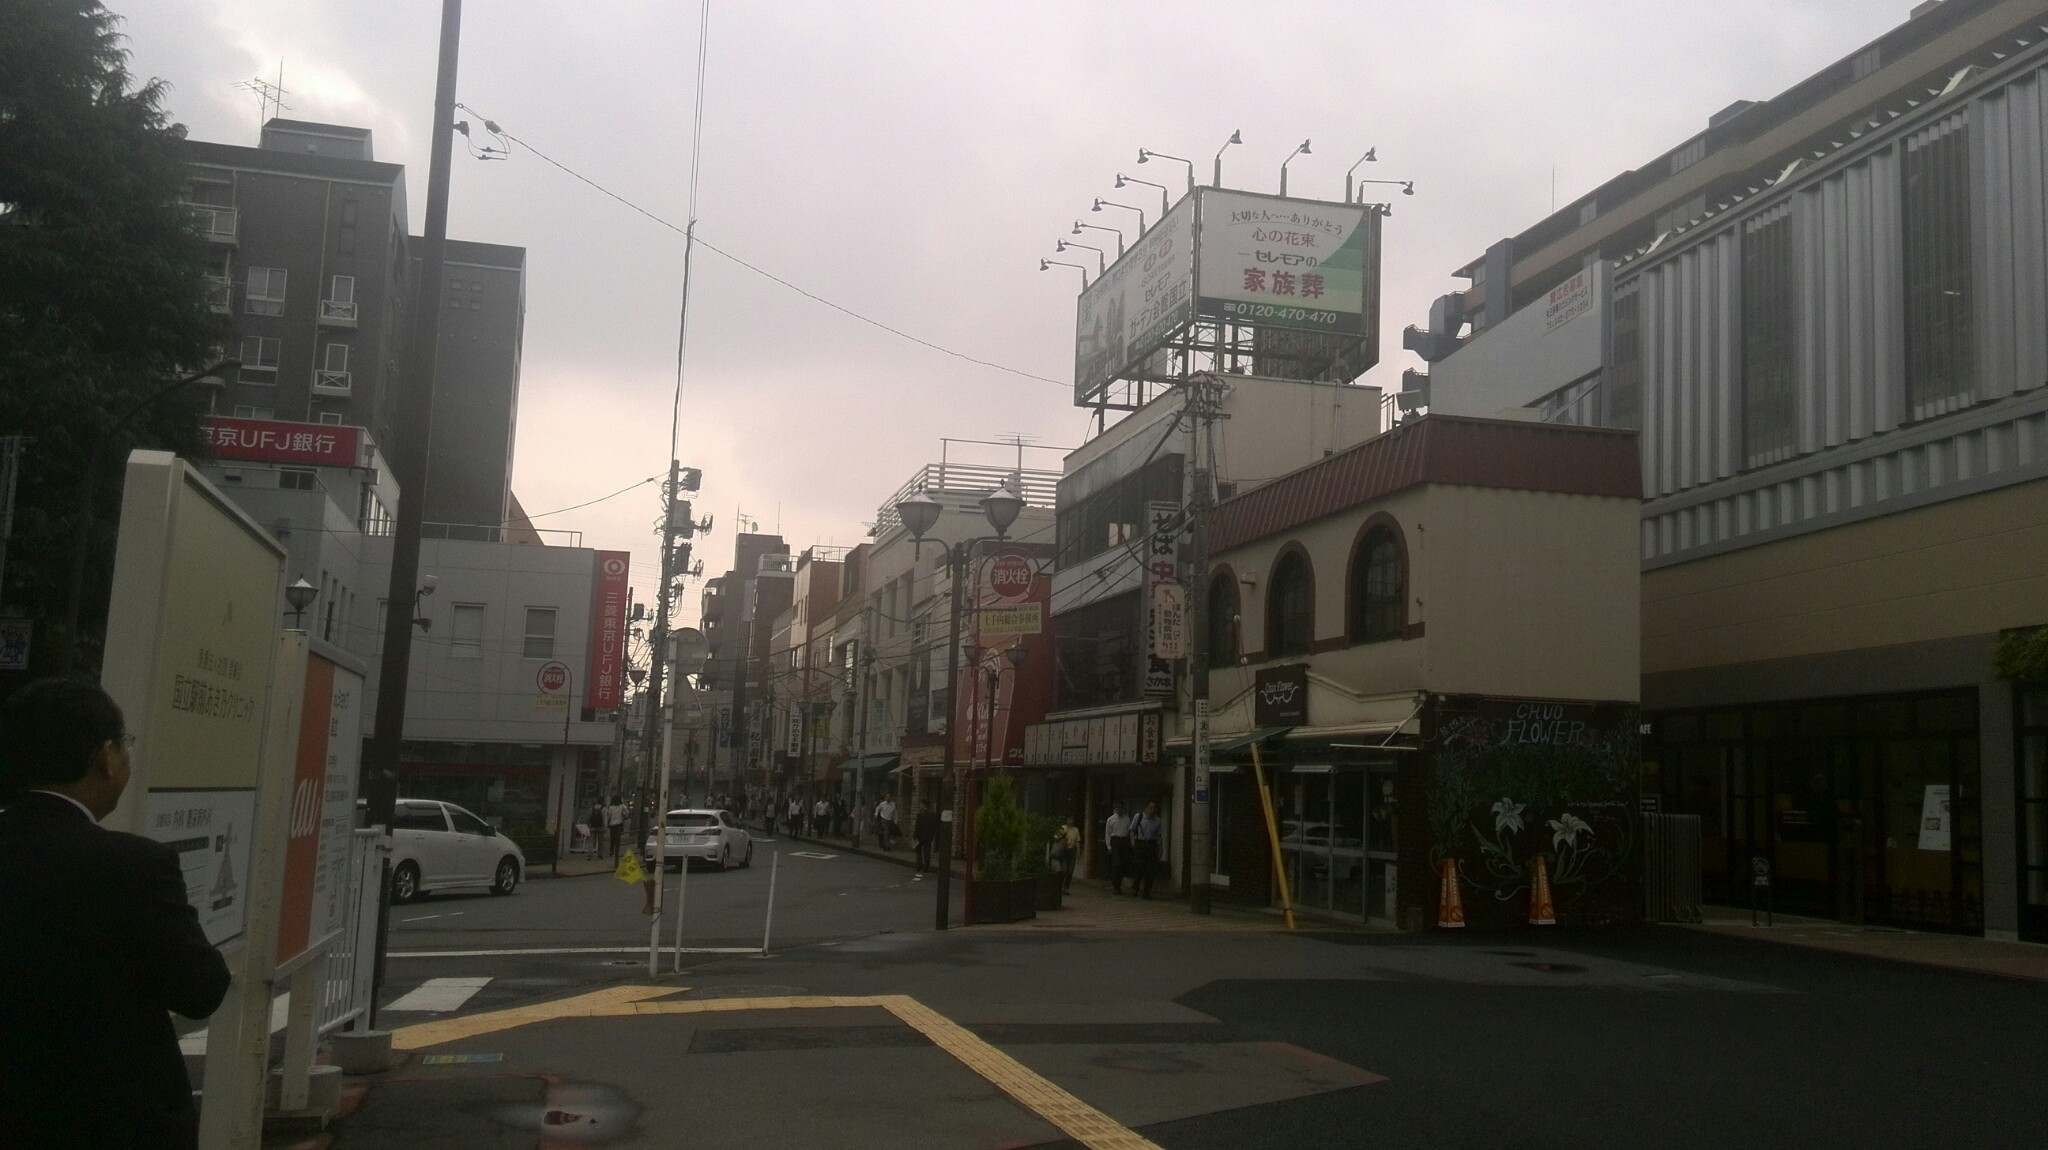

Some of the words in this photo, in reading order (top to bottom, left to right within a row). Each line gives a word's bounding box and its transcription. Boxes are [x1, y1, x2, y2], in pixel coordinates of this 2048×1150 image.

[1252, 228, 1316, 247] 心の花束
[1254, 250, 1318, 268] セレモアの
[1144, 272, 1171, 302] セレモア
[1243, 267, 1325, 299] 家族葬
[1130, 280, 1187, 340] ガーデン会館国立
[1237, 303, 1337, 324] 0120-470-470
[994, 568, 1029, 585] 消火栓
[1172, 604, 1181, 626] ほんだ
[598, 591, 618, 700] 三菱東京UFJ銀行
[1516, 704, 1563, 719] CHUO
[1502, 718, 1585, 745] FLOWER
[290, 778, 321, 839] au
